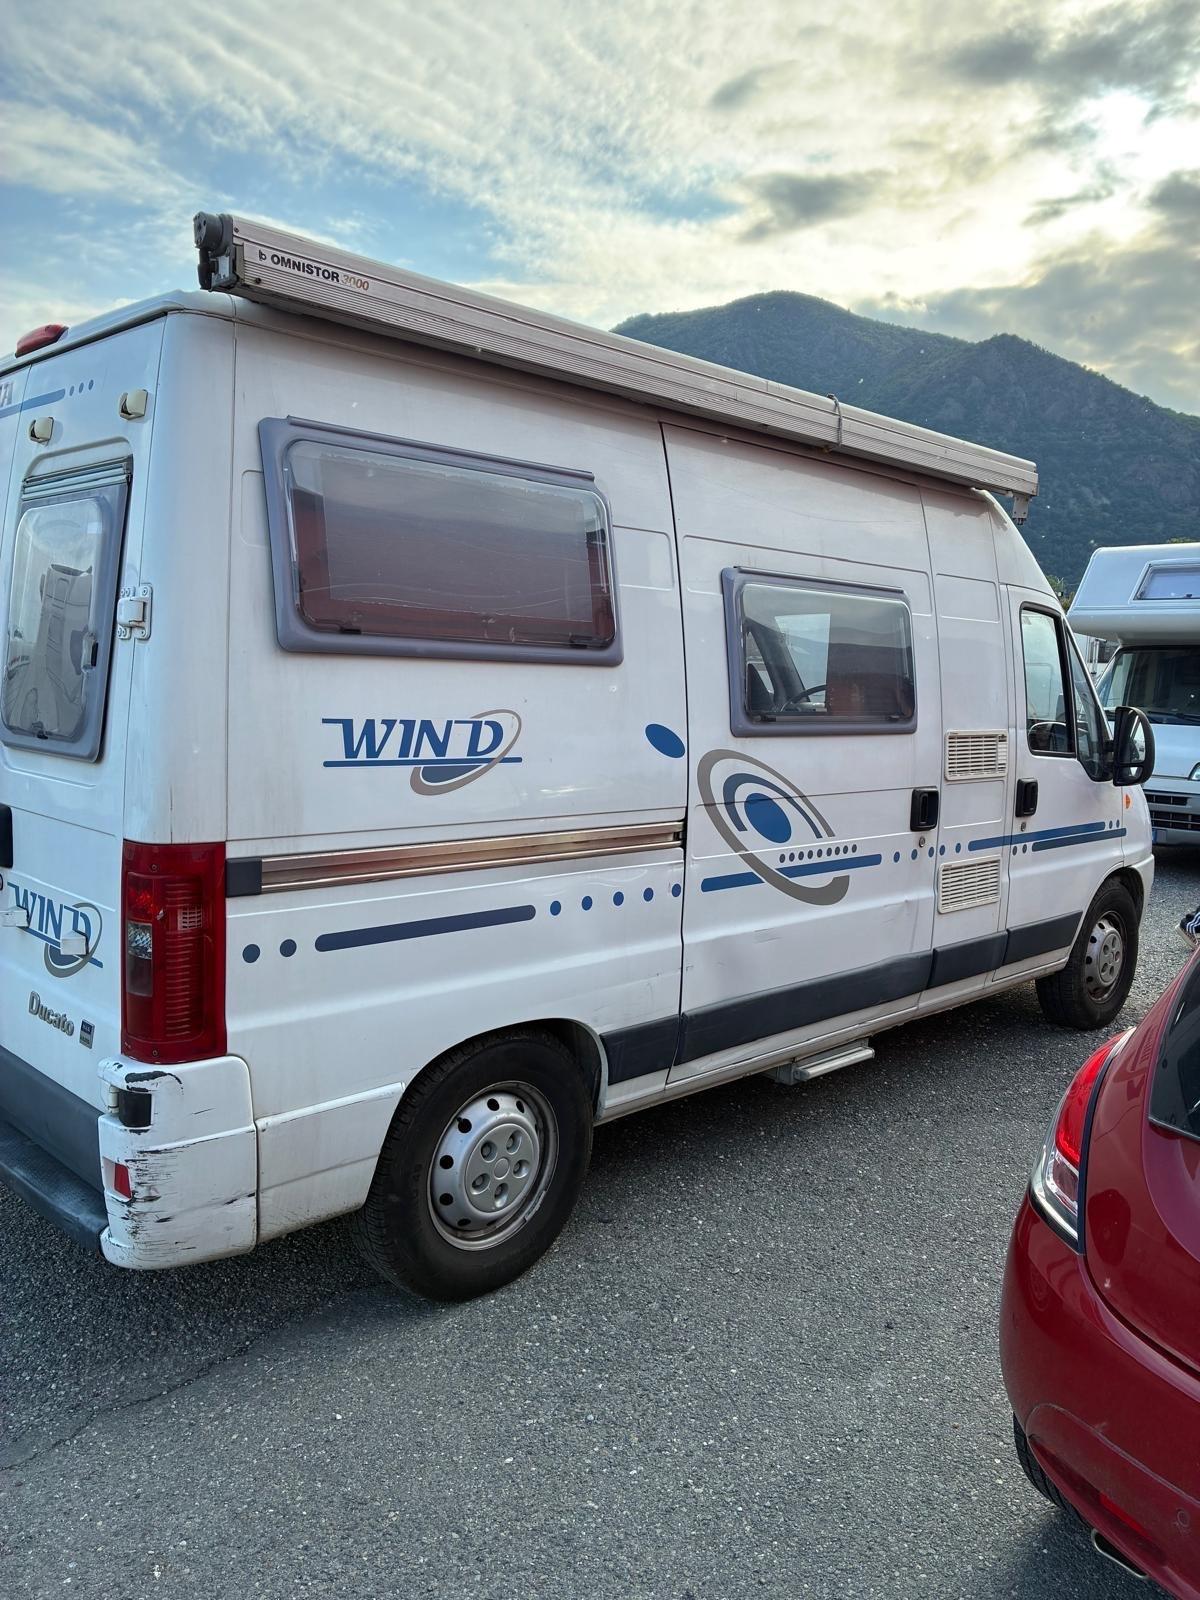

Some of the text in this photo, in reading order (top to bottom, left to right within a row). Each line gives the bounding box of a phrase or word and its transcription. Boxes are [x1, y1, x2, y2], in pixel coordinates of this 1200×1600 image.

[270, 253, 370, 291] OMNISTOR 3000
[322, 718, 504, 759] WIND
[7, 881, 92, 941] WIND
[29, 990, 75, 1037] Ducato
